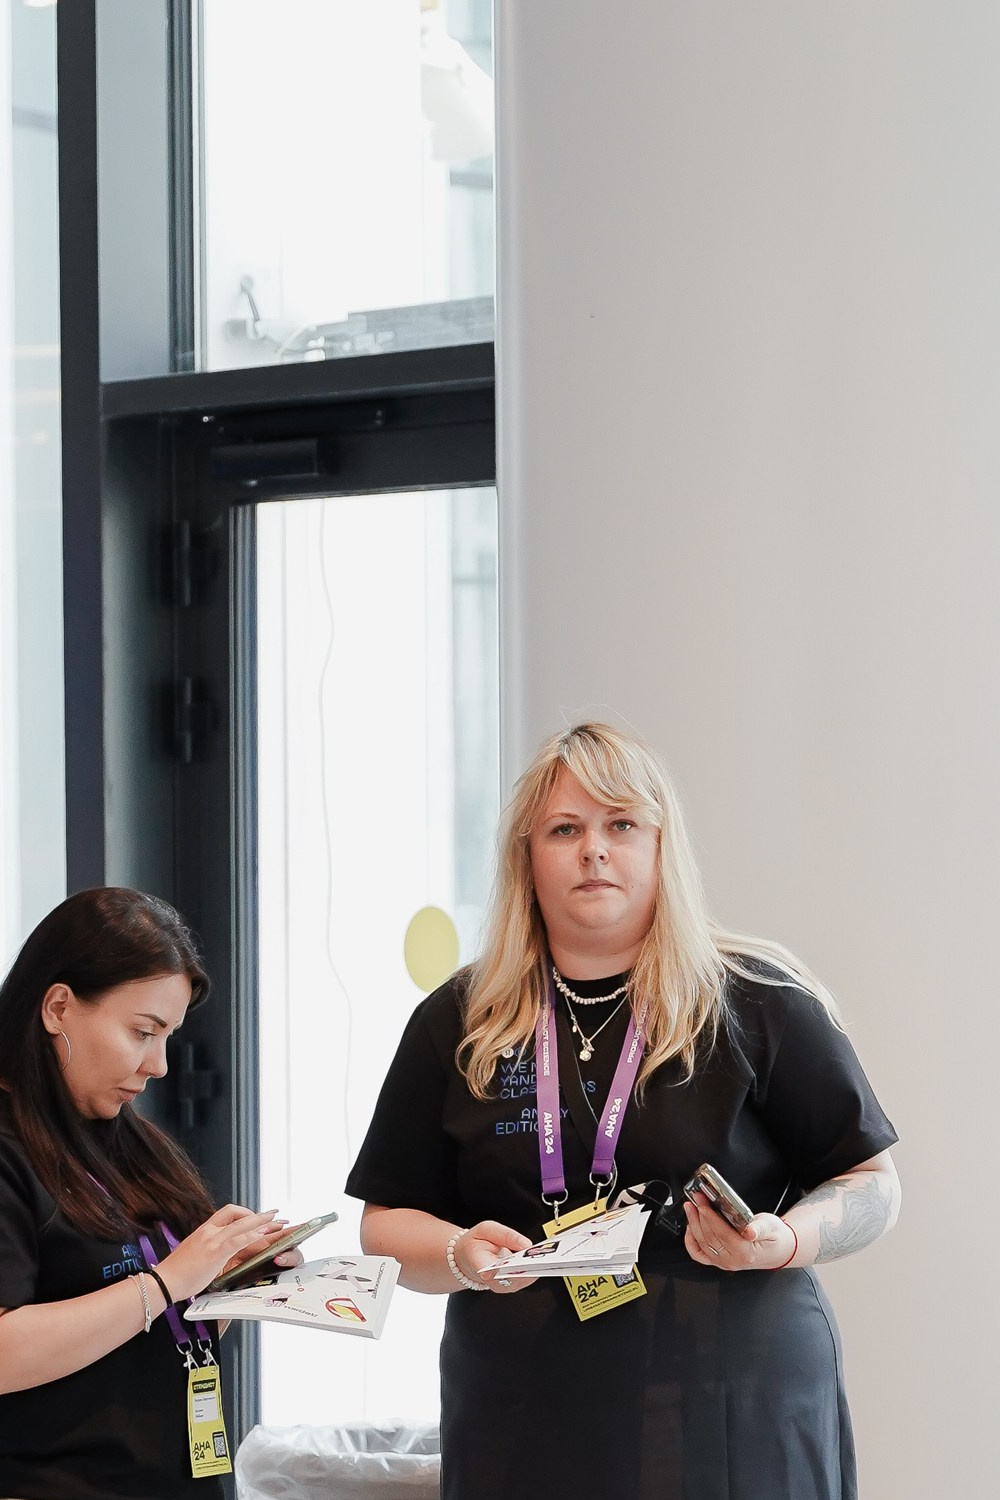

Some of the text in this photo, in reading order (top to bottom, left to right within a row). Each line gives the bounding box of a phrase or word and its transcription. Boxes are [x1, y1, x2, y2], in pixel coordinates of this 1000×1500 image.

[500, 1062, 527, 1075] WE
[543, 1111, 554, 1155] AHA'24
[605, 1097, 623, 1138] AHA'24
